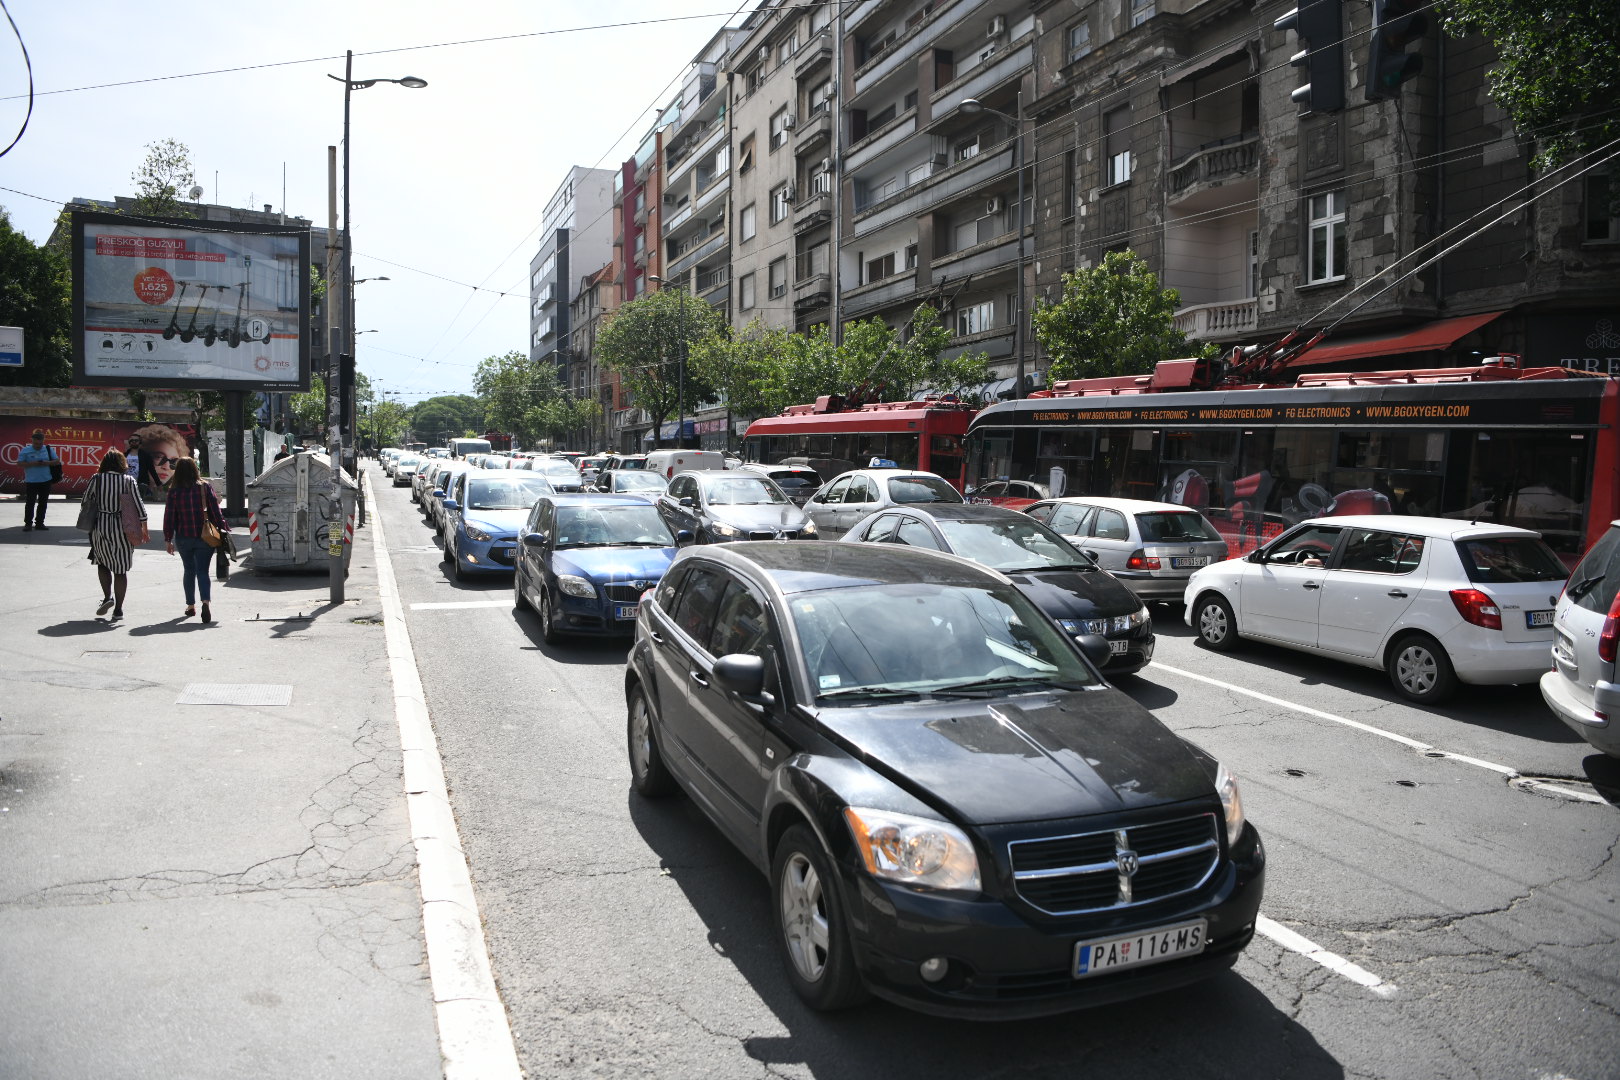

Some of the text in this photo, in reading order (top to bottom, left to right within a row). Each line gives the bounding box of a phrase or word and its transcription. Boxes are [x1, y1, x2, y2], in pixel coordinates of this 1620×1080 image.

[97, 236, 184, 249] PRESKOČI GUŽVU!
[139, 282, 168, 292] 1.625
[1040, 412, 1070, 421] ELECTRONICS
[1077, 411, 1132, 420] WWW.BGOXYGEN.COM
[1141, 411, 1149, 420] FG
[1150, 410, 1188, 419] ELECTRONICS
[1199, 409, 1273, 419] WWW.BGOXYGEN.COM
[1285, 408, 1296, 417] FG
[1297, 407, 1351, 417] ELECTRONICS
[1366, 405, 1470, 417] WWW.BGOXYGEN.COM
[622, 608, 633, 616] BG
[1532, 613, 1541, 624] BG
[1093, 943, 1117, 968] PA
